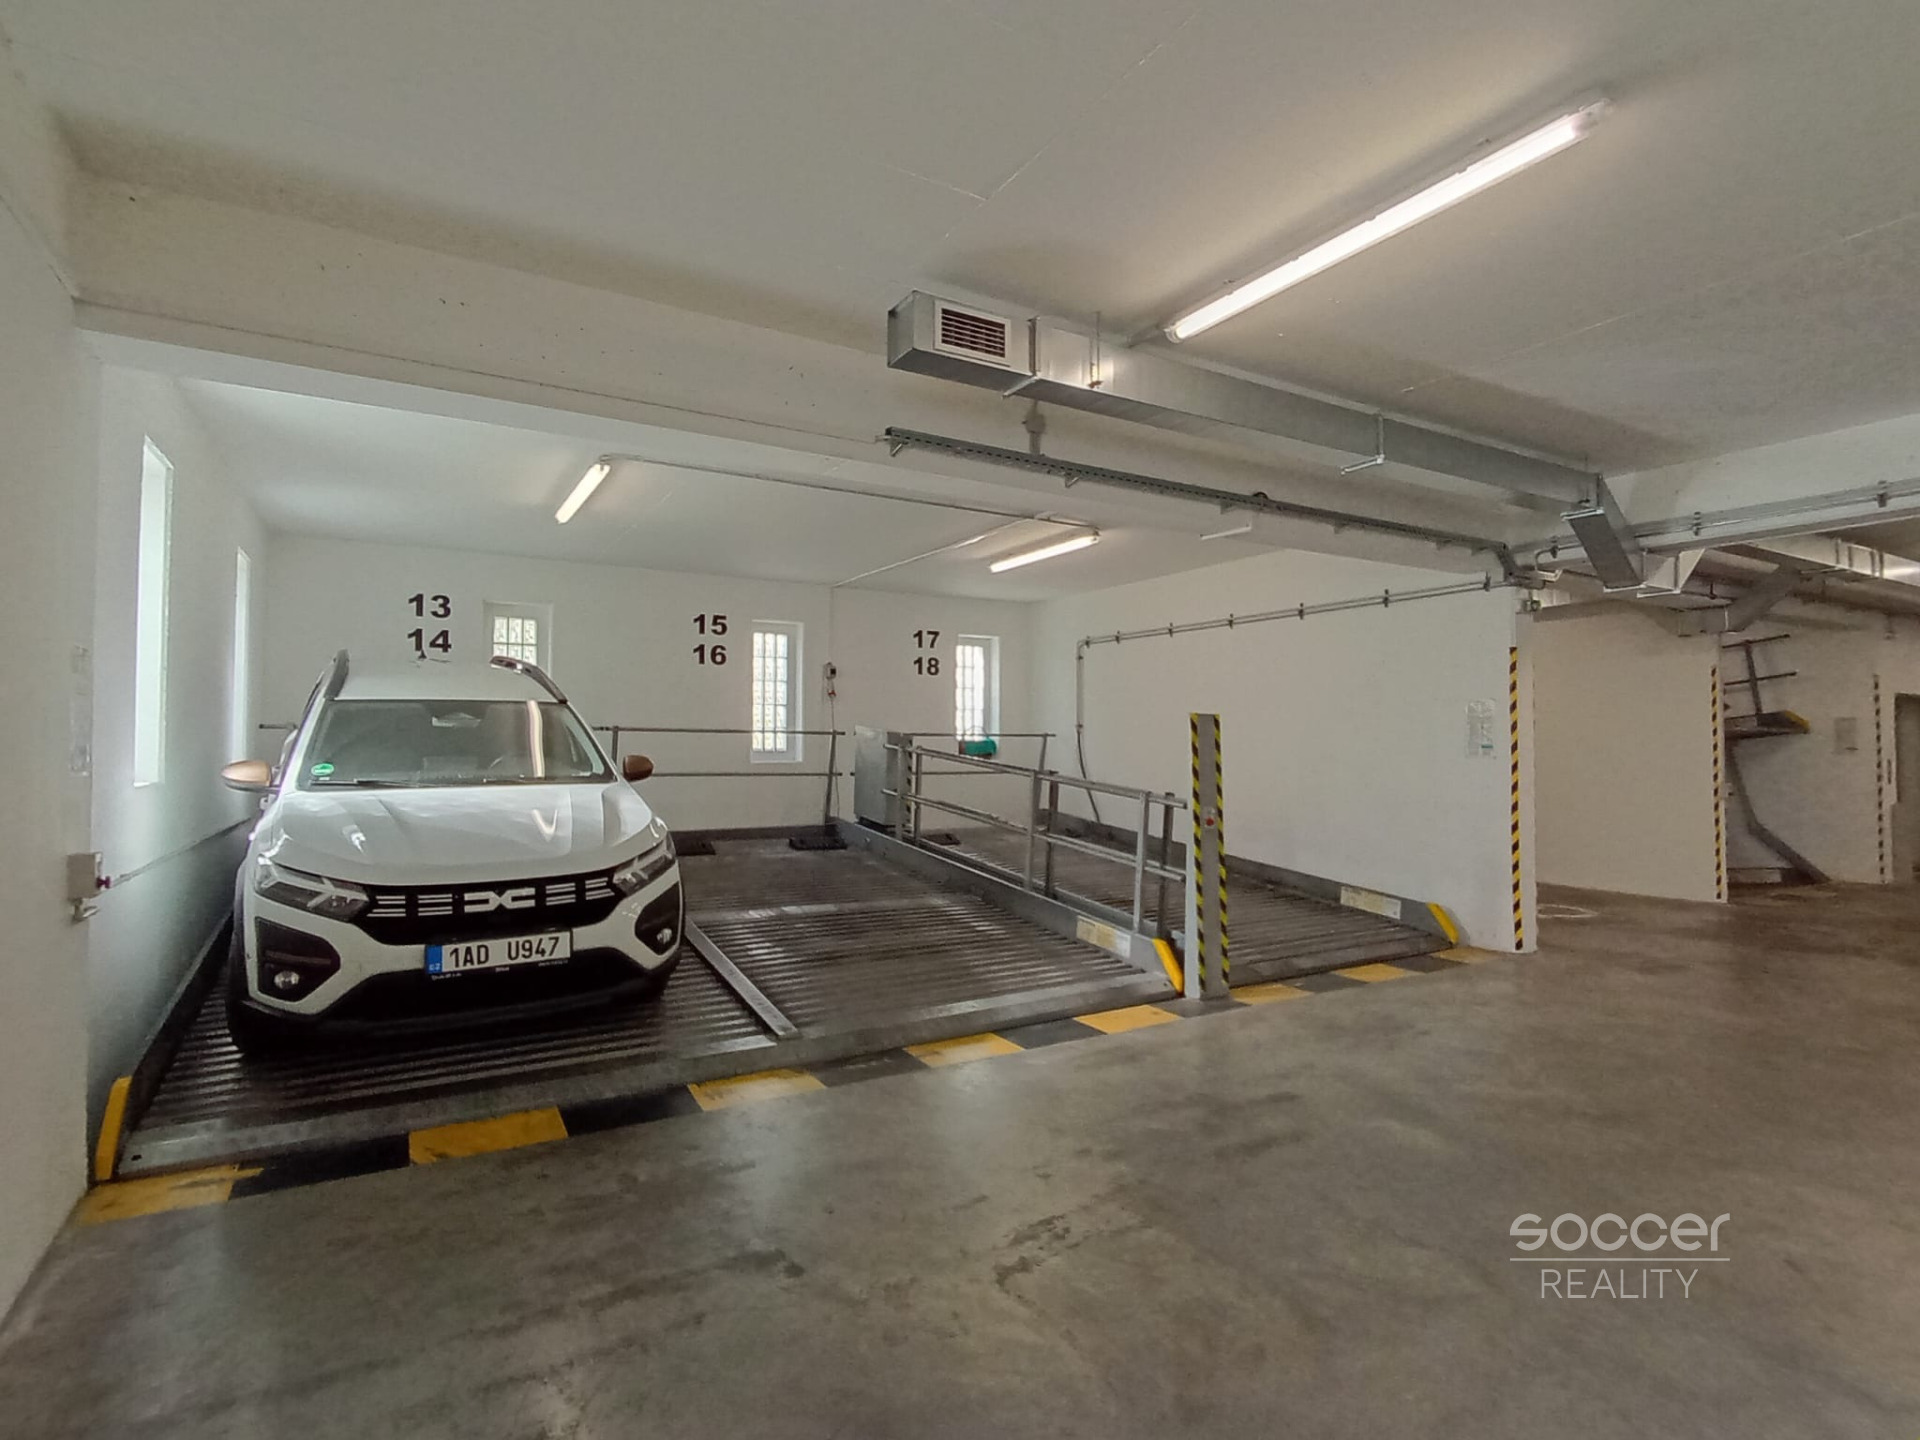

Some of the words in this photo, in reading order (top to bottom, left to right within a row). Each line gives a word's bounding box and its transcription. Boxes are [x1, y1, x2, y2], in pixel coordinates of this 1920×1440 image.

[408, 593, 451, 618] 13
[693, 613, 728, 636] 15
[407, 628, 452, 653] 14
[913, 629, 940, 649] 17
[692, 643, 727, 666] 16
[913, 656, 940, 676] 18
[449, 944, 490, 968] 1AD
[507, 936, 560, 961] U947
